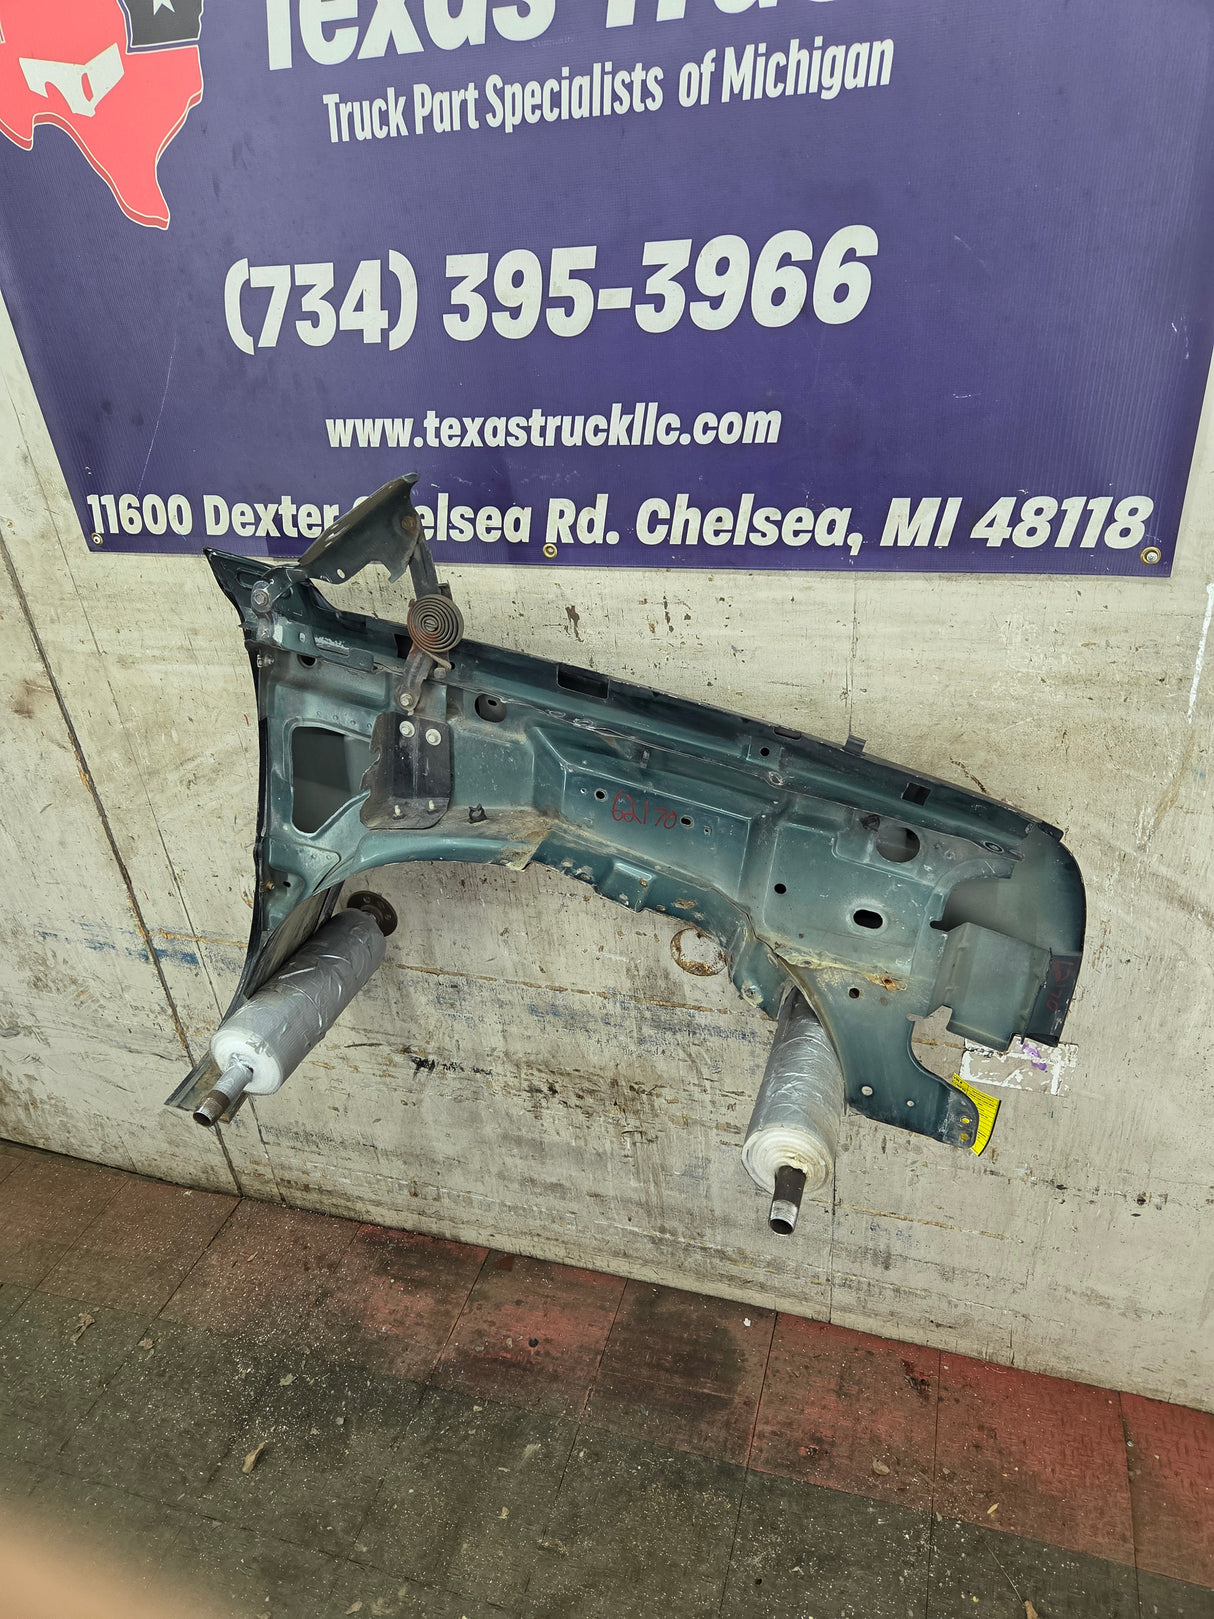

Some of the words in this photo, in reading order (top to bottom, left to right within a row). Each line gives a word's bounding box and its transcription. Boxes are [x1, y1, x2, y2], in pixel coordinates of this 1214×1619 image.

[322, 86, 409, 143] Truck
[413, 82, 480, 135] Part
[485, 61, 664, 134] Specialists
[678, 48, 717, 108] of
[721, 35, 895, 103] Michigan
[224, 249, 418, 356] (734)
[442, 224, 880, 342] 395-3966
[325, 402, 782, 448] www.texastruckllc.com
[86, 493, 193, 535] 11600
[202, 494, 340, 539] Dexter
[352, 493, 532, 543] elsea
[545, 493, 620, 545] Rd.
[635, 493, 863, 556] Chelsea,
[879, 497, 963, 547] MI
[969, 495, 1154, 550] 48118
